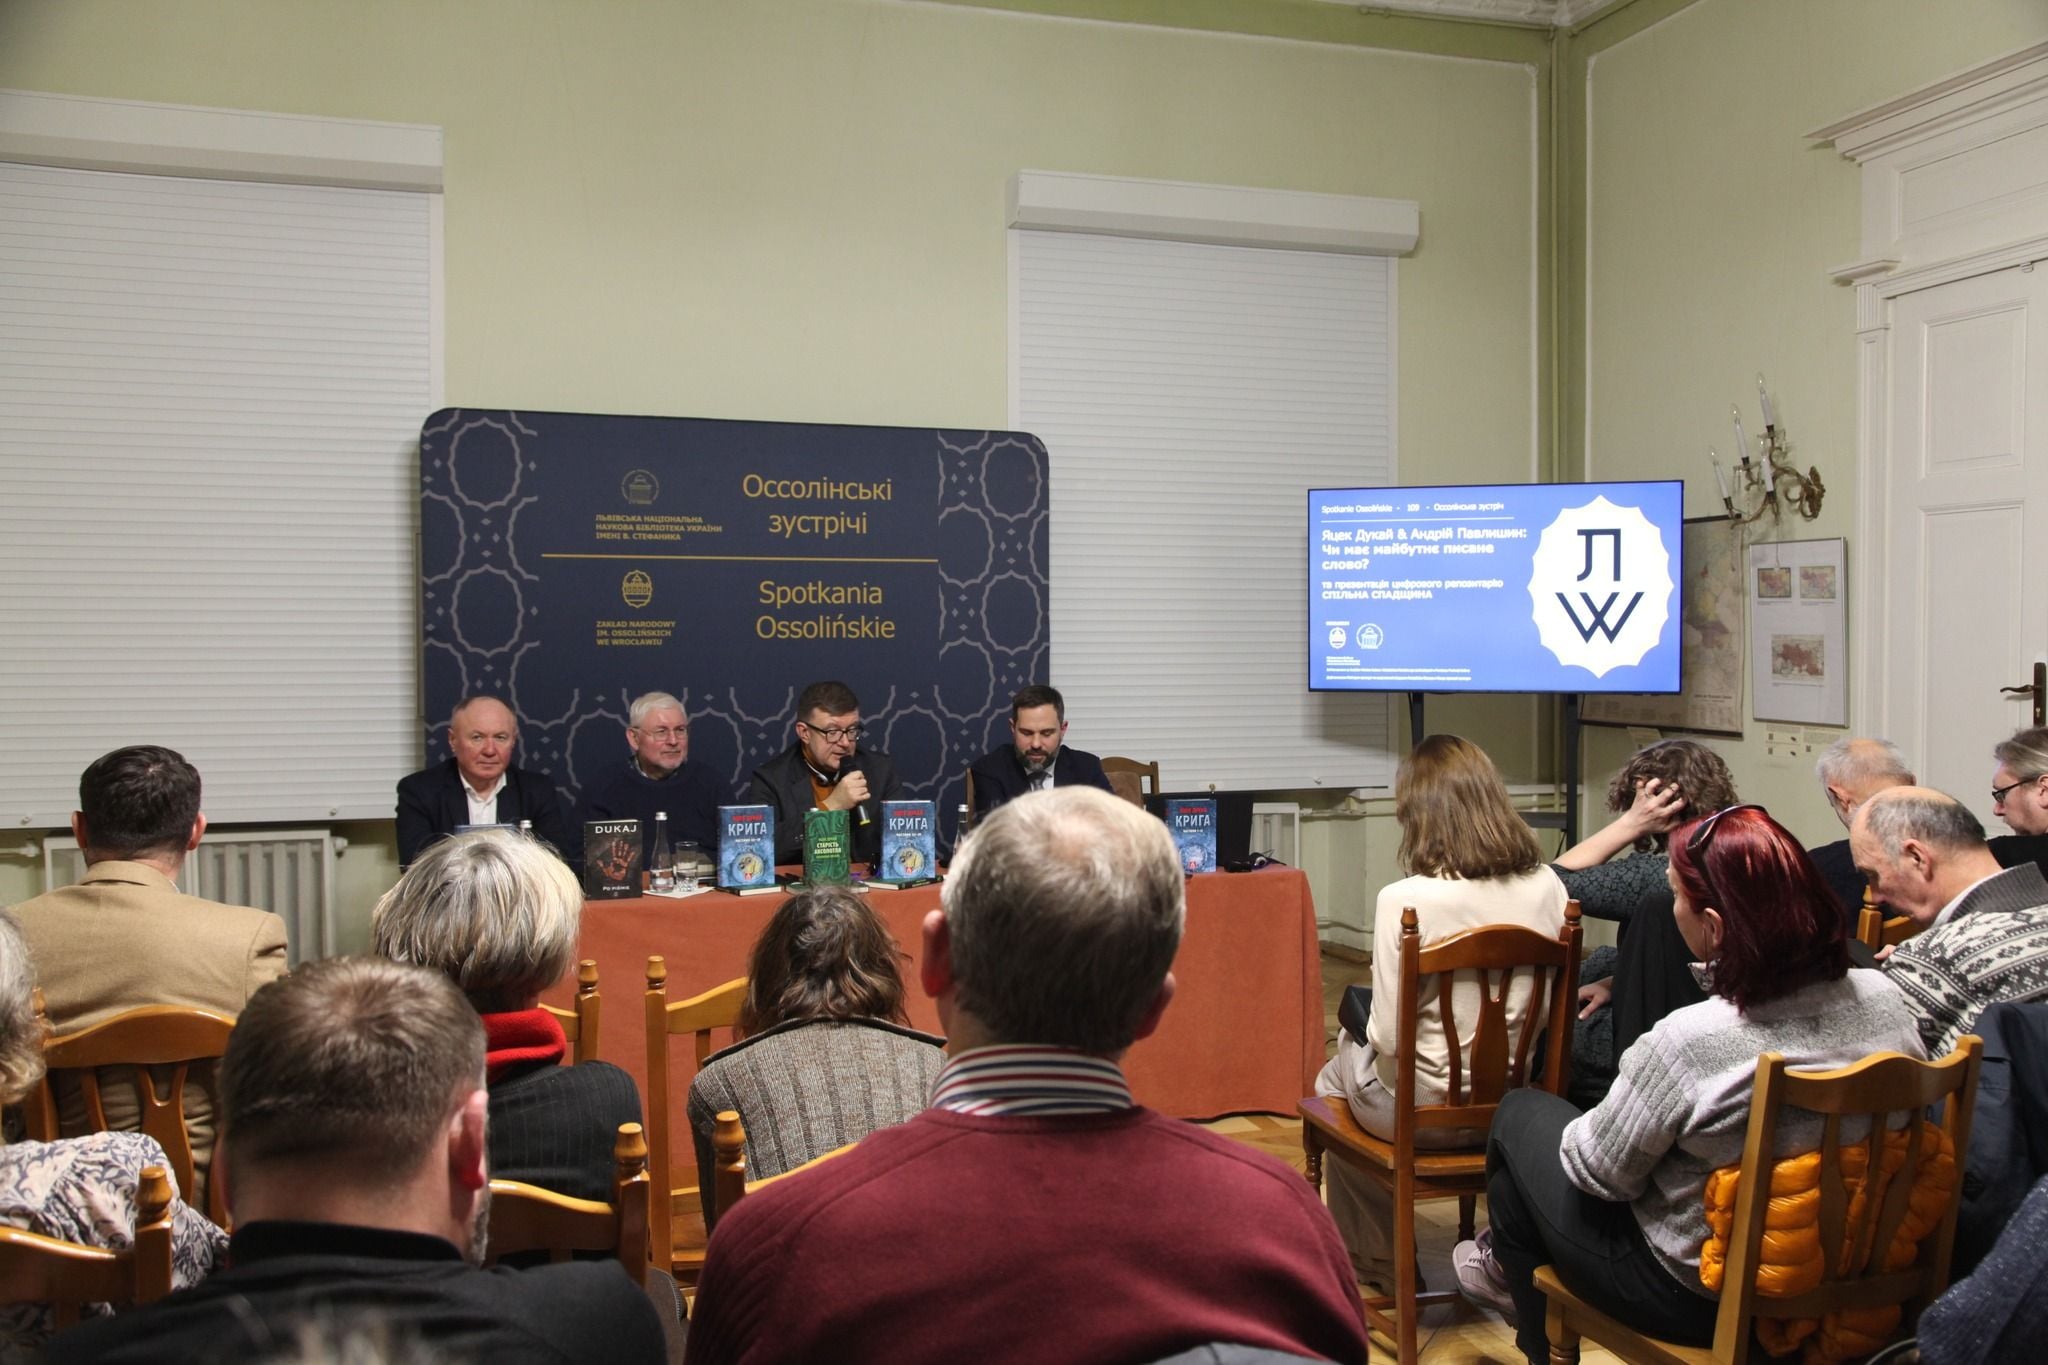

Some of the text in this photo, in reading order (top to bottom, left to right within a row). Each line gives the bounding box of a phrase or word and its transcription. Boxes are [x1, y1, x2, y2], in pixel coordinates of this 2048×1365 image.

[743, 474, 891, 500] Оссолінські
[596, 514, 703, 523] ЛЬВІВСЬКА НАЦІОНАЛЬНА
[636, 524, 685, 532] БІБЛІОТЕКА
[687, 524, 722, 532] УКРАЇНИ
[769, 512, 867, 539] зустрічі
[596, 532, 620, 540] ІМЕНІ
[1322, 527, 1527, 542] Яцек Дукай & Андрій Павлишин:
[1322, 543, 1494, 557] Чи має майбутнє писане
[1577, 528, 1621, 582] Л
[1322, 558, 1369, 570] слово?
[760, 581, 882, 608] Spotkania
[1322, 590, 1432, 600] СПІЛЬНА СПАДЩИНА
[1555, 592, 1645, 644] W
[612, 628, 672, 636] OSSOLIŃSKICH
[756, 614, 895, 638] Ossolińskie
[889, 817, 928, 830] КРИГА
[1175, 814, 1210, 827] КРИГА
[595, 824, 637, 834] DUKAJ
[728, 822, 767, 836] КРИГА
